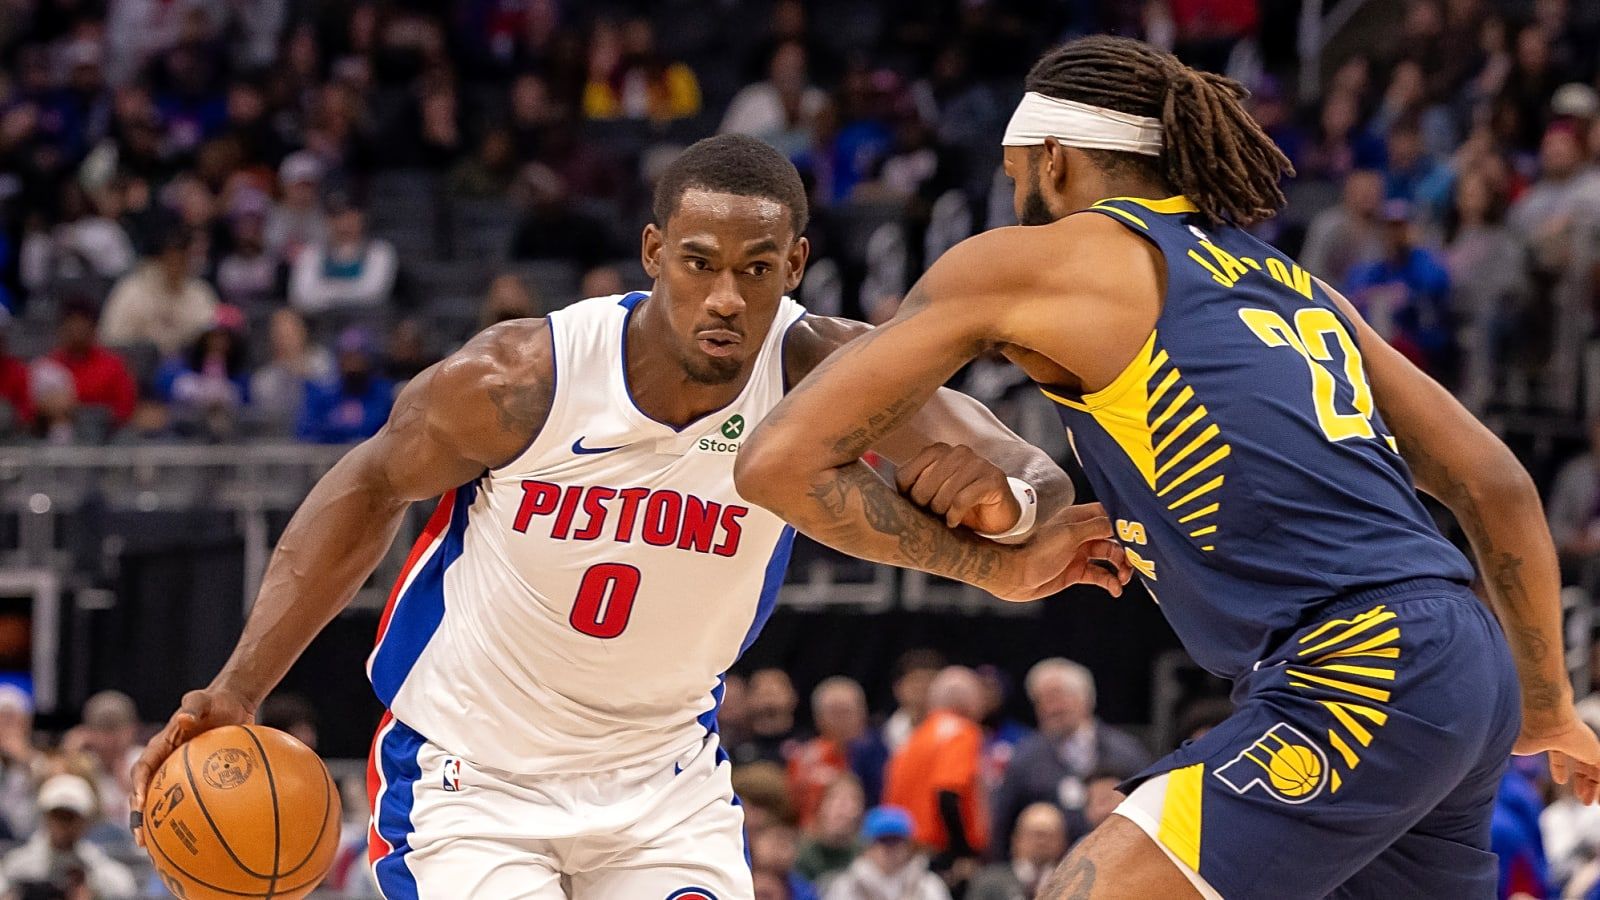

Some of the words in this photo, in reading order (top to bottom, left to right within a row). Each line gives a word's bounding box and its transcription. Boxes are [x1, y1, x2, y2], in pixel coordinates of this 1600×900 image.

[698, 438, 741, 453] Stoc
[512, 479, 748, 557] PISTONS
[569, 562, 641, 639] 0
